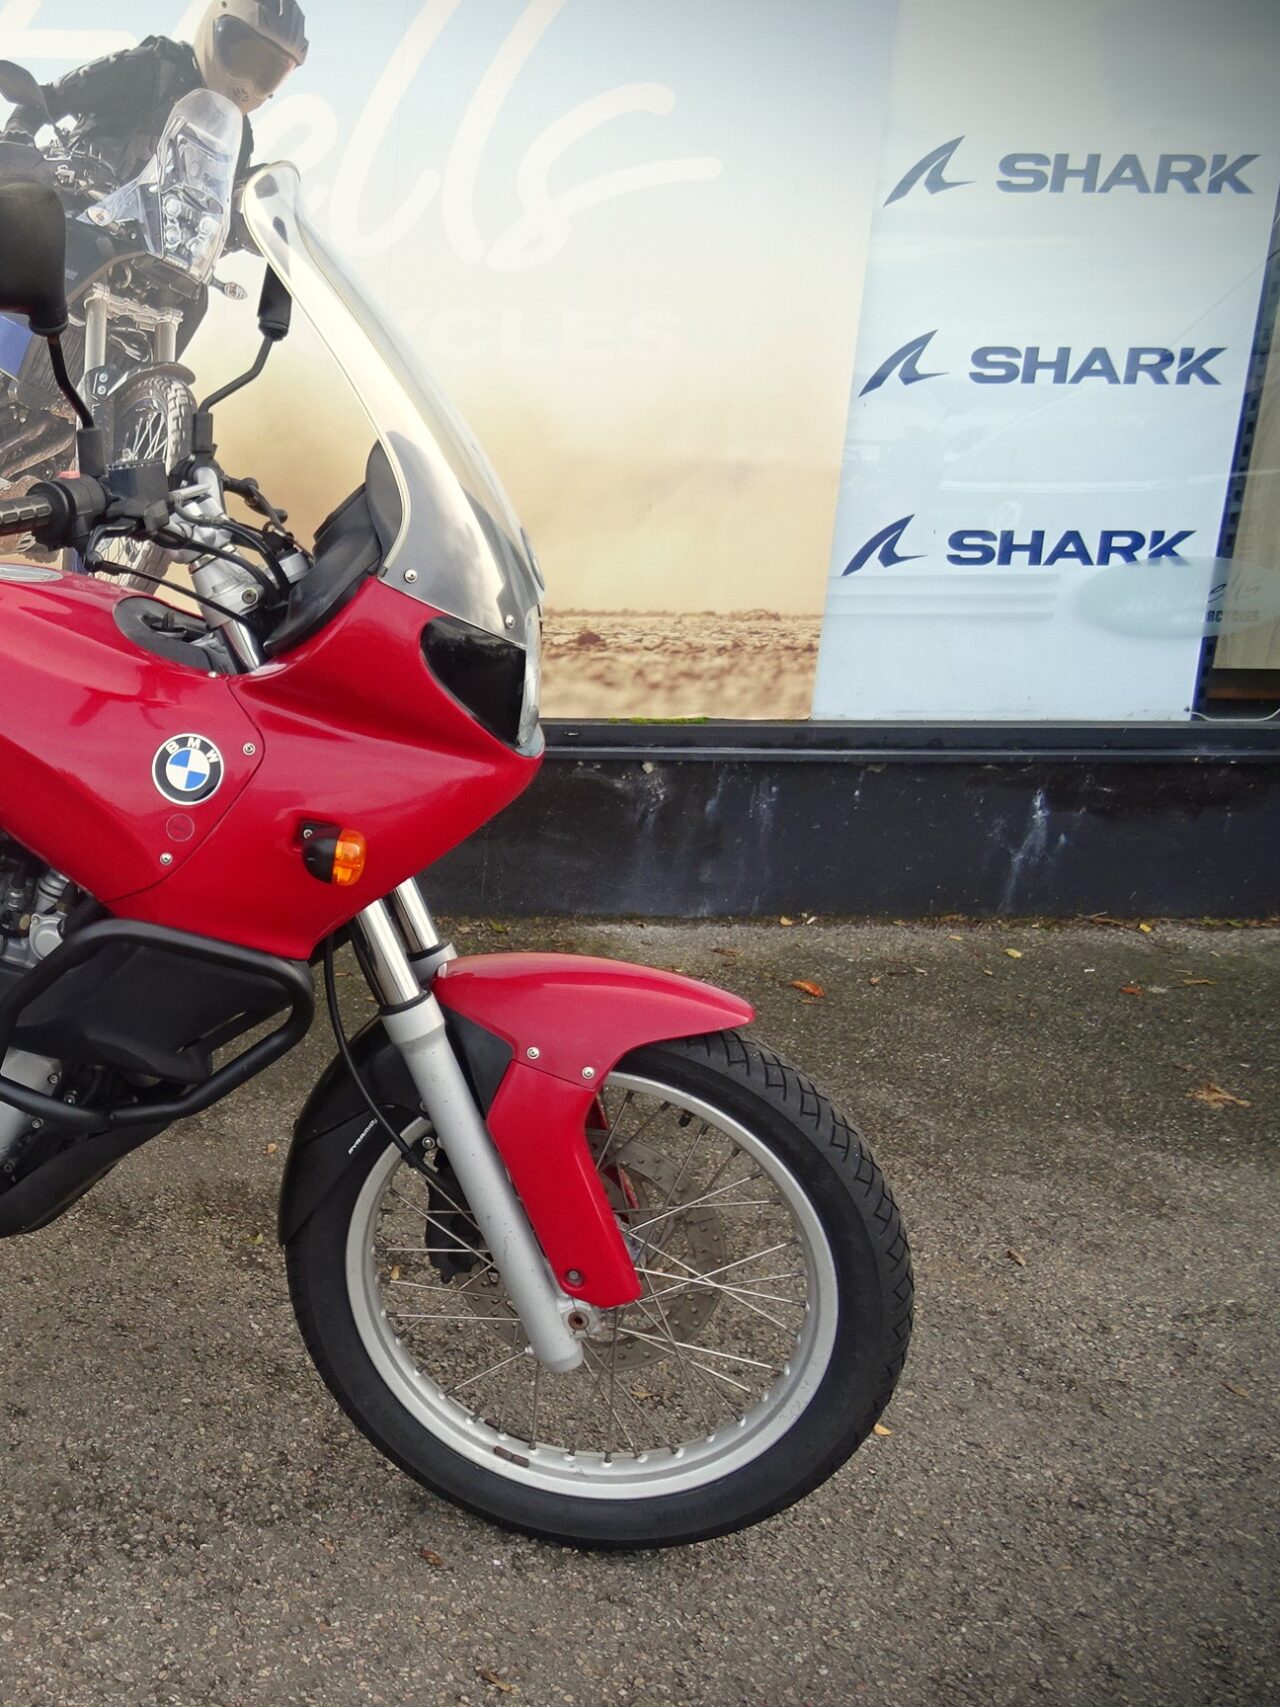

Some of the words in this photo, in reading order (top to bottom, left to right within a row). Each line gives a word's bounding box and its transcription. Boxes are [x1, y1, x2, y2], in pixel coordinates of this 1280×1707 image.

[995, 152, 1261, 195] SHARK
[968, 346, 1228, 386] SHARK
[945, 529, 1198, 567] SHARK
[165, 736, 220, 764] BMW
